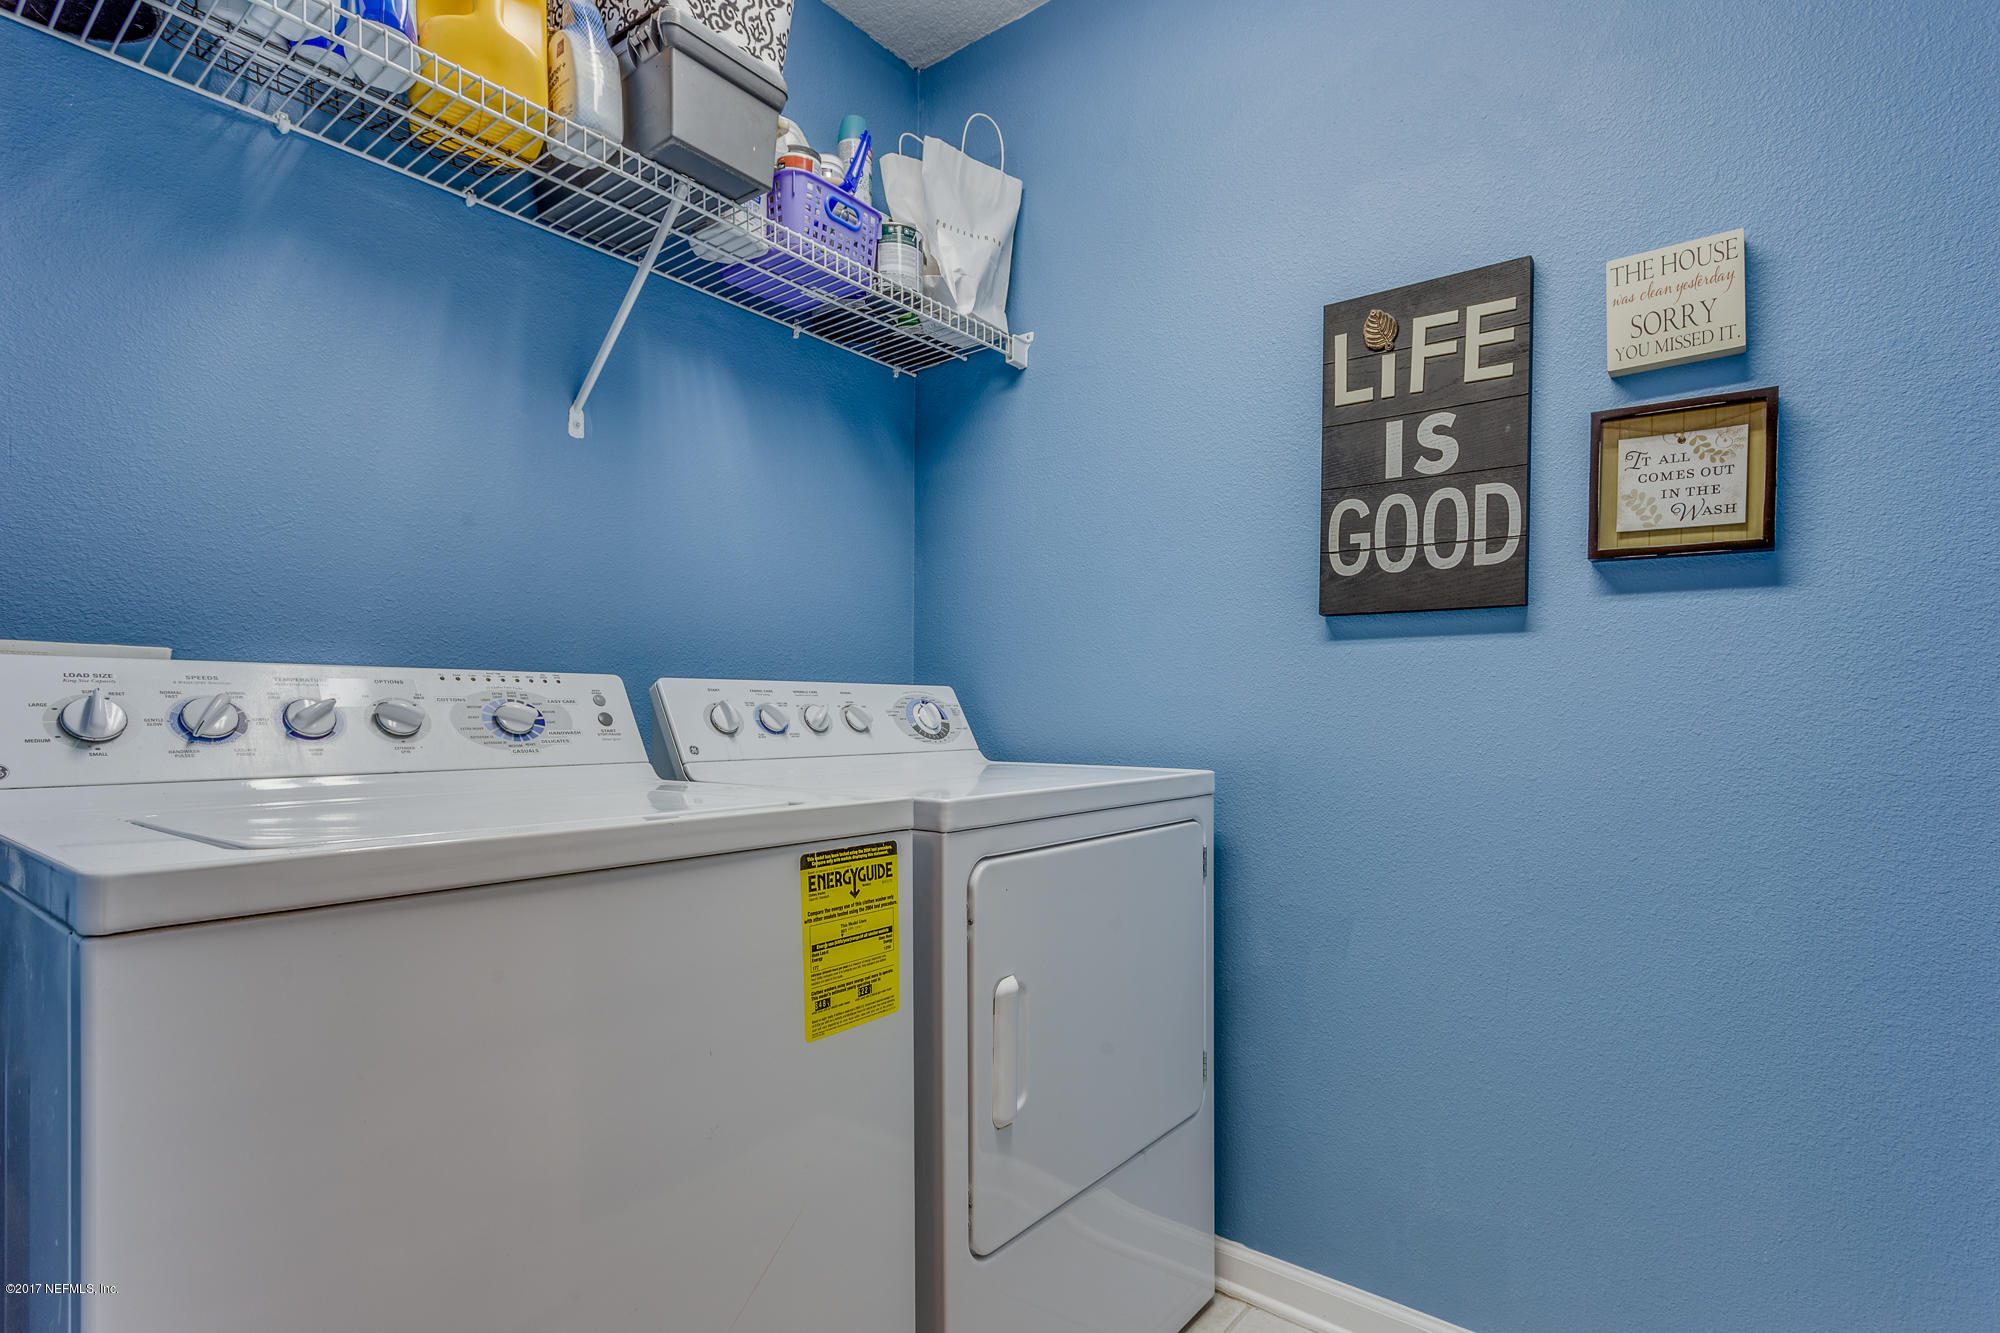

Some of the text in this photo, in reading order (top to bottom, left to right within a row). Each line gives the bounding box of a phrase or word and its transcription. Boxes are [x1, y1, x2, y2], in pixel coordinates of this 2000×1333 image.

[1609, 237, 1739, 287] THE HOUSE
[1612, 292, 1635, 308] was
[1639, 284, 1673, 303] clean
[1629, 297, 1718, 339] SORRY
[1615, 323, 1741, 361] YOU MISSED IT.
[1385, 411, 1460, 480] IS
[1658, 450, 1690, 465] ALL
[1637, 463, 1735, 484] COMES OUT
[1660, 483, 1721, 499] IN THE
[1328, 482, 1522, 577] GOOD
[808, 861, 893, 892] ENERGYGUIDE
